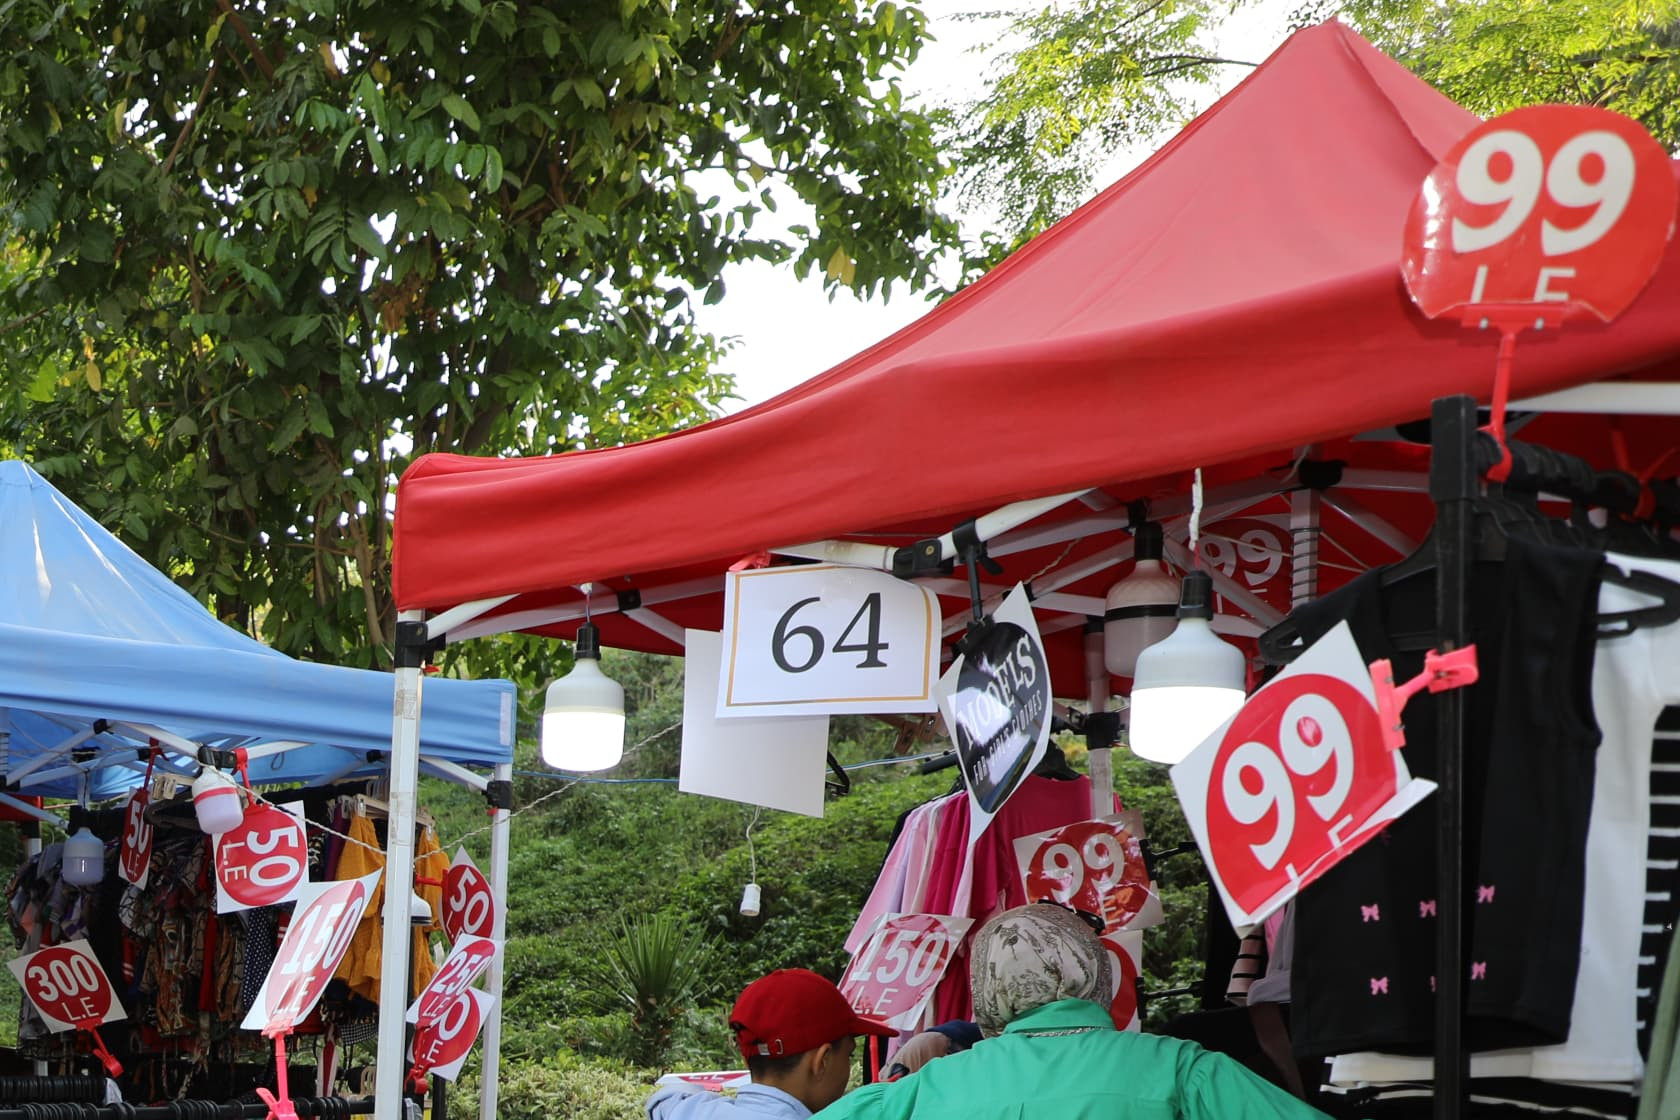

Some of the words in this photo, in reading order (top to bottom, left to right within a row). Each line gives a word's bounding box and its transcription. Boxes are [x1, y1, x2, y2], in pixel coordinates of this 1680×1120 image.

[1452, 129, 1636, 257] 99
[771, 592, 889, 674] 64
[956, 633, 1037, 751] MODELS
[973, 757, 990, 786] FOR
[1222, 692, 1355, 871] 99
[222, 840, 248, 883] L.E
[246, 825, 301, 888] 50
[1042, 832, 1126, 905] 99
[449, 866, 490, 935] 50
[280, 896, 364, 975] 150
[851, 928, 947, 987] 150
[27, 954, 100, 1002] 300
[430, 950, 491, 997] 250
[852, 985, 899, 1015] L.E
[61, 996, 100, 1021] L.E
